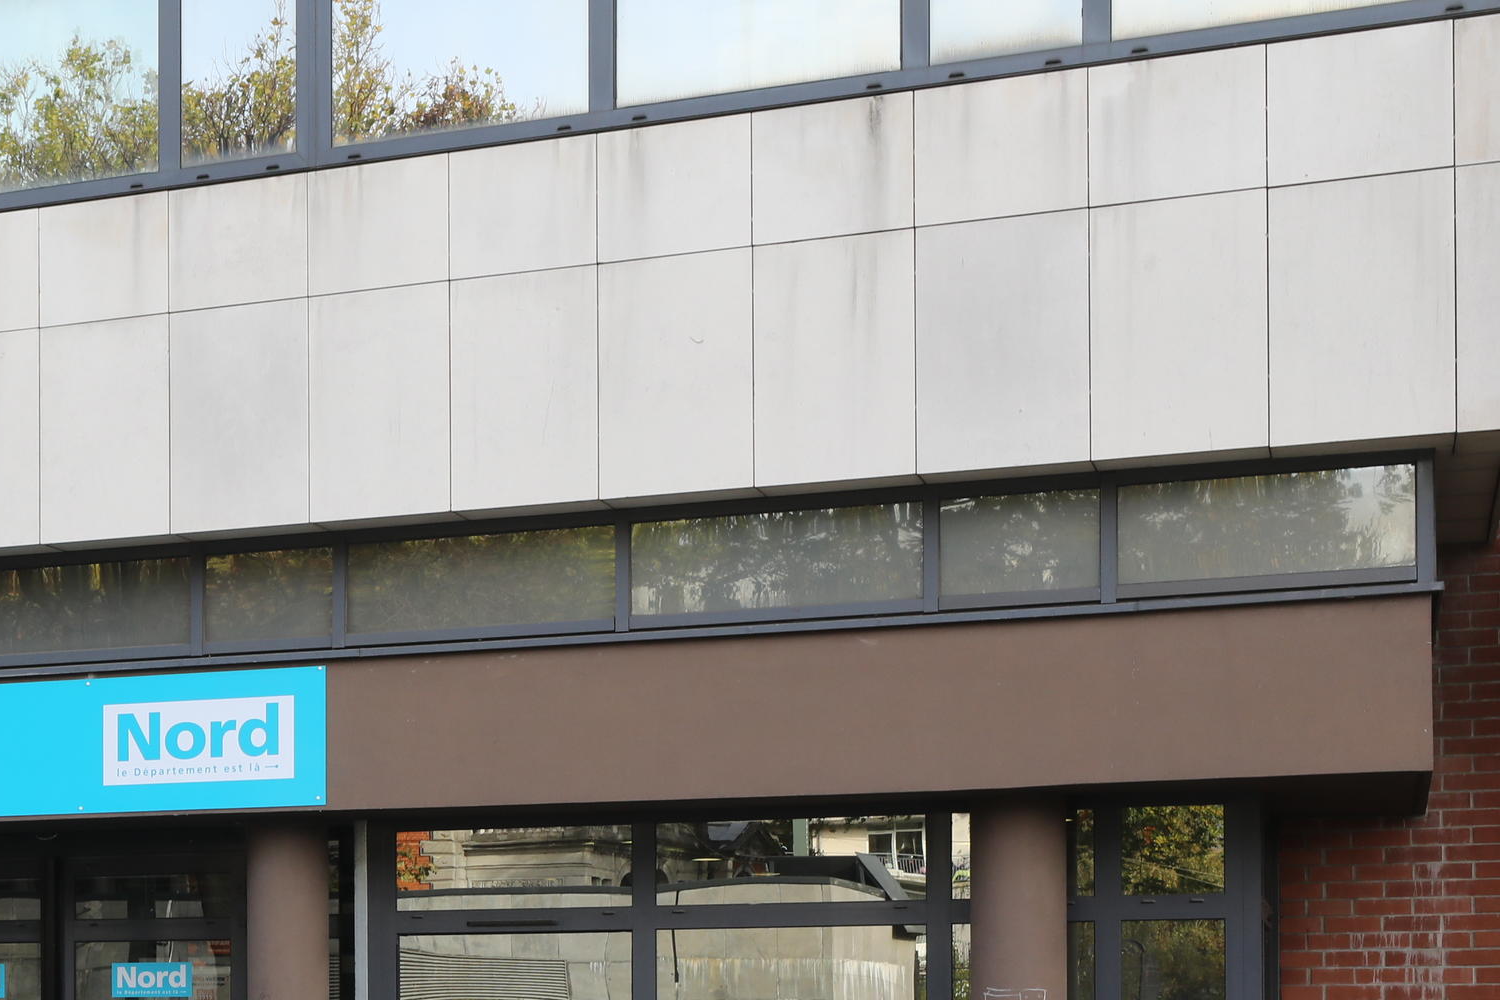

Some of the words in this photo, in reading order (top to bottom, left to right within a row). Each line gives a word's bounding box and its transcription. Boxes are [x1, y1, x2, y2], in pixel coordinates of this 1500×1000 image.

[117, 702, 279, 762] Nord
[116, 767, 128, 777] le
[133, 765, 218, 778] Département
[223, 764, 243, 773] est
[249, 762, 261, 772] là
[117, 964, 187, 989] Nord
